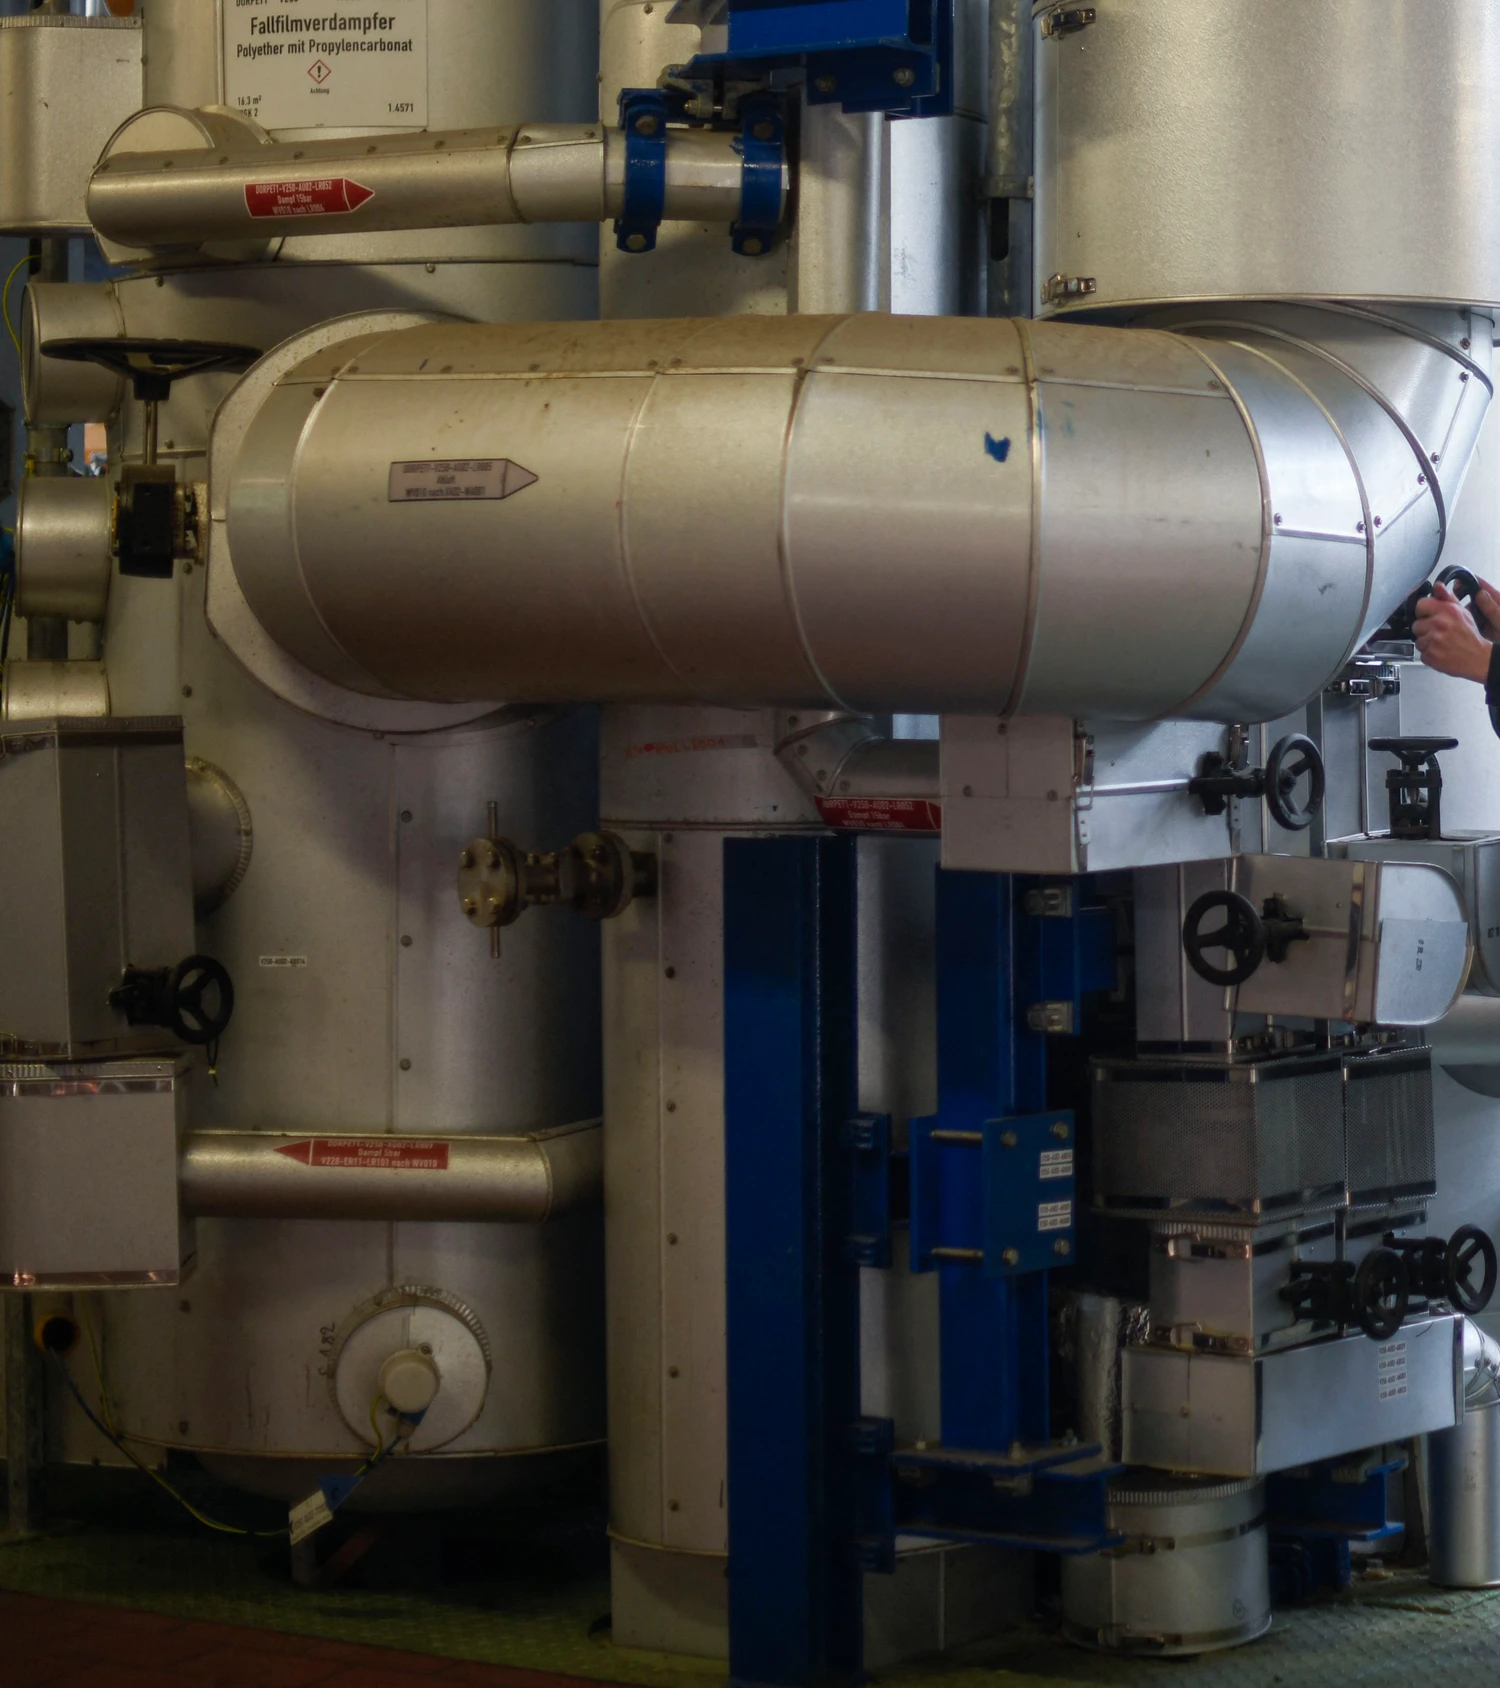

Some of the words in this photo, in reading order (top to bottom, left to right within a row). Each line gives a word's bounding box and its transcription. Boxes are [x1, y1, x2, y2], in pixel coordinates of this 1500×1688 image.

[250, 12, 396, 35] Fallfilmverdampfer
[236, 42, 284, 60] Polyether
[287, 40, 305, 55] mit
[308, 38, 413, 57] Propylencarbonat
[310, 87, 330, 95] Achtung
[237, 96, 251, 106] 16.3
[253, 108, 258, 117] 2
[388, 103, 414, 113] 1.4571
[277, 195, 295, 204] Dampf
[357, 1149, 382, 1157] Dampf
[391, 1159, 410, 1167] nach
